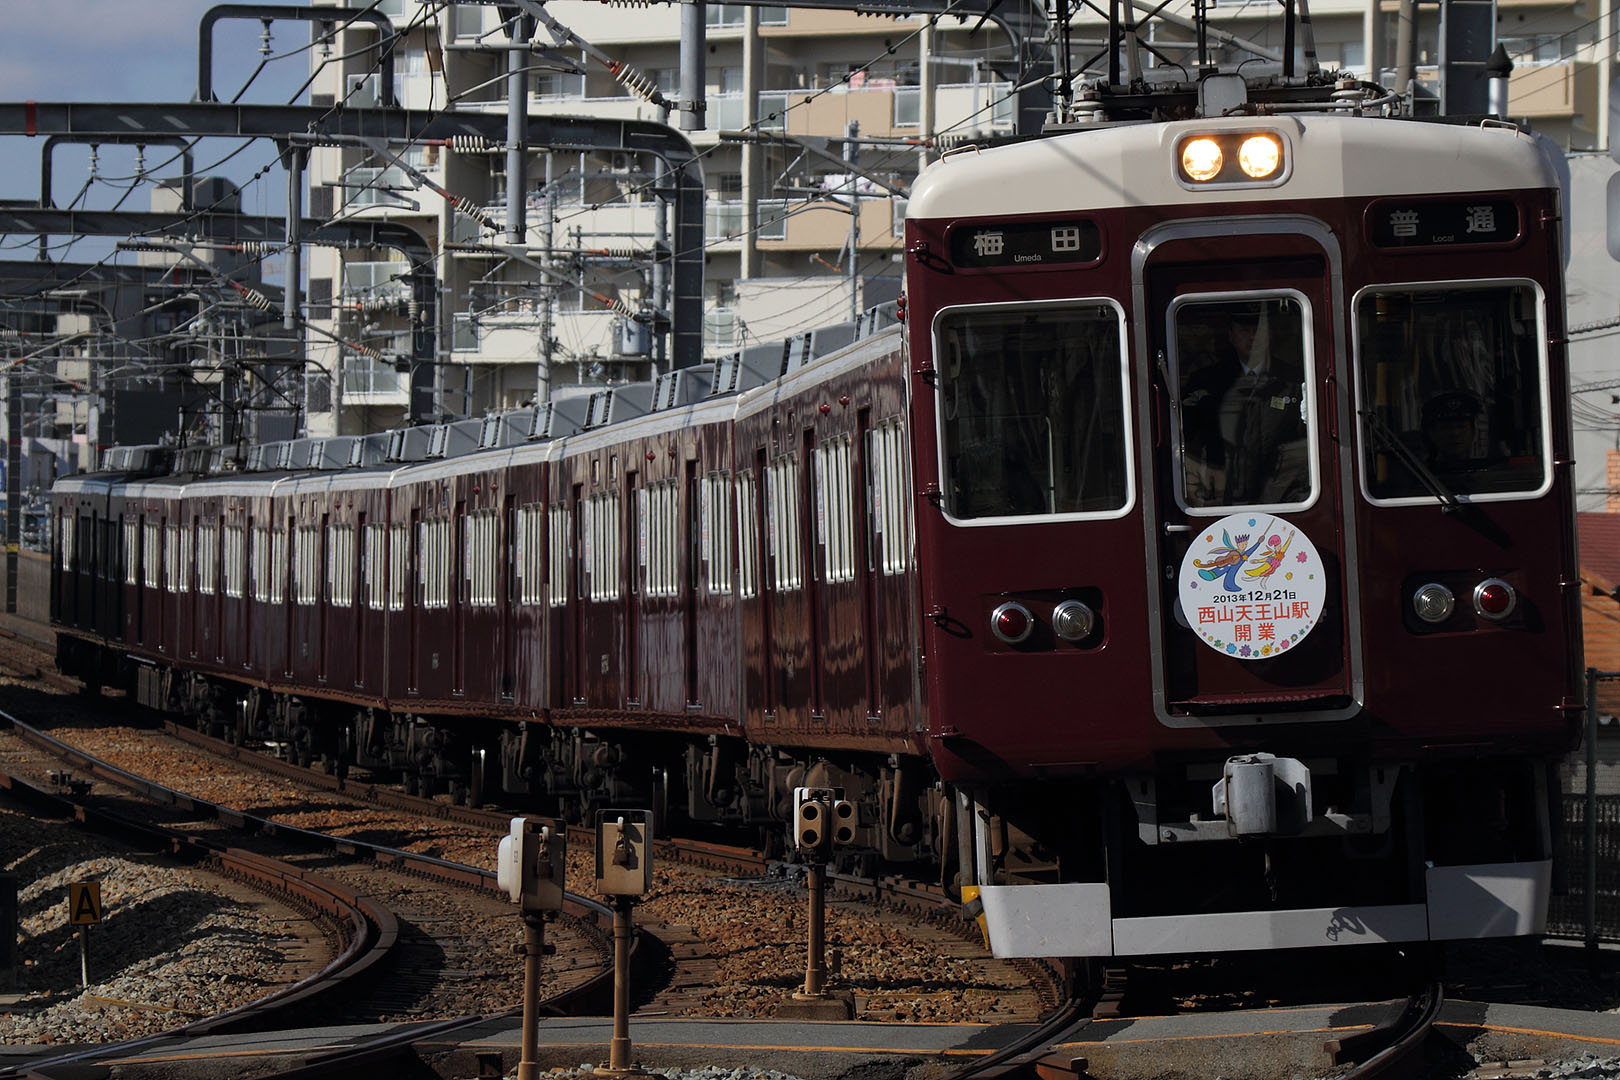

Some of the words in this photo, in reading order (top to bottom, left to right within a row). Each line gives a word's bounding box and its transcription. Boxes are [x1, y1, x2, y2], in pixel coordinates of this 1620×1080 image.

[1389, 206, 1496, 237] 普通
[973, 226, 1080, 257] 梅田
[1432, 234, 1455, 243] Local
[1014, 253, 1042, 263] Umeda
[1213, 589, 1296, 603] 2013年12月21日
[1198, 601, 1310, 624] 西山天王山駅
[1234, 622, 1276, 642] 開業
[74, 886, 98, 921] A
